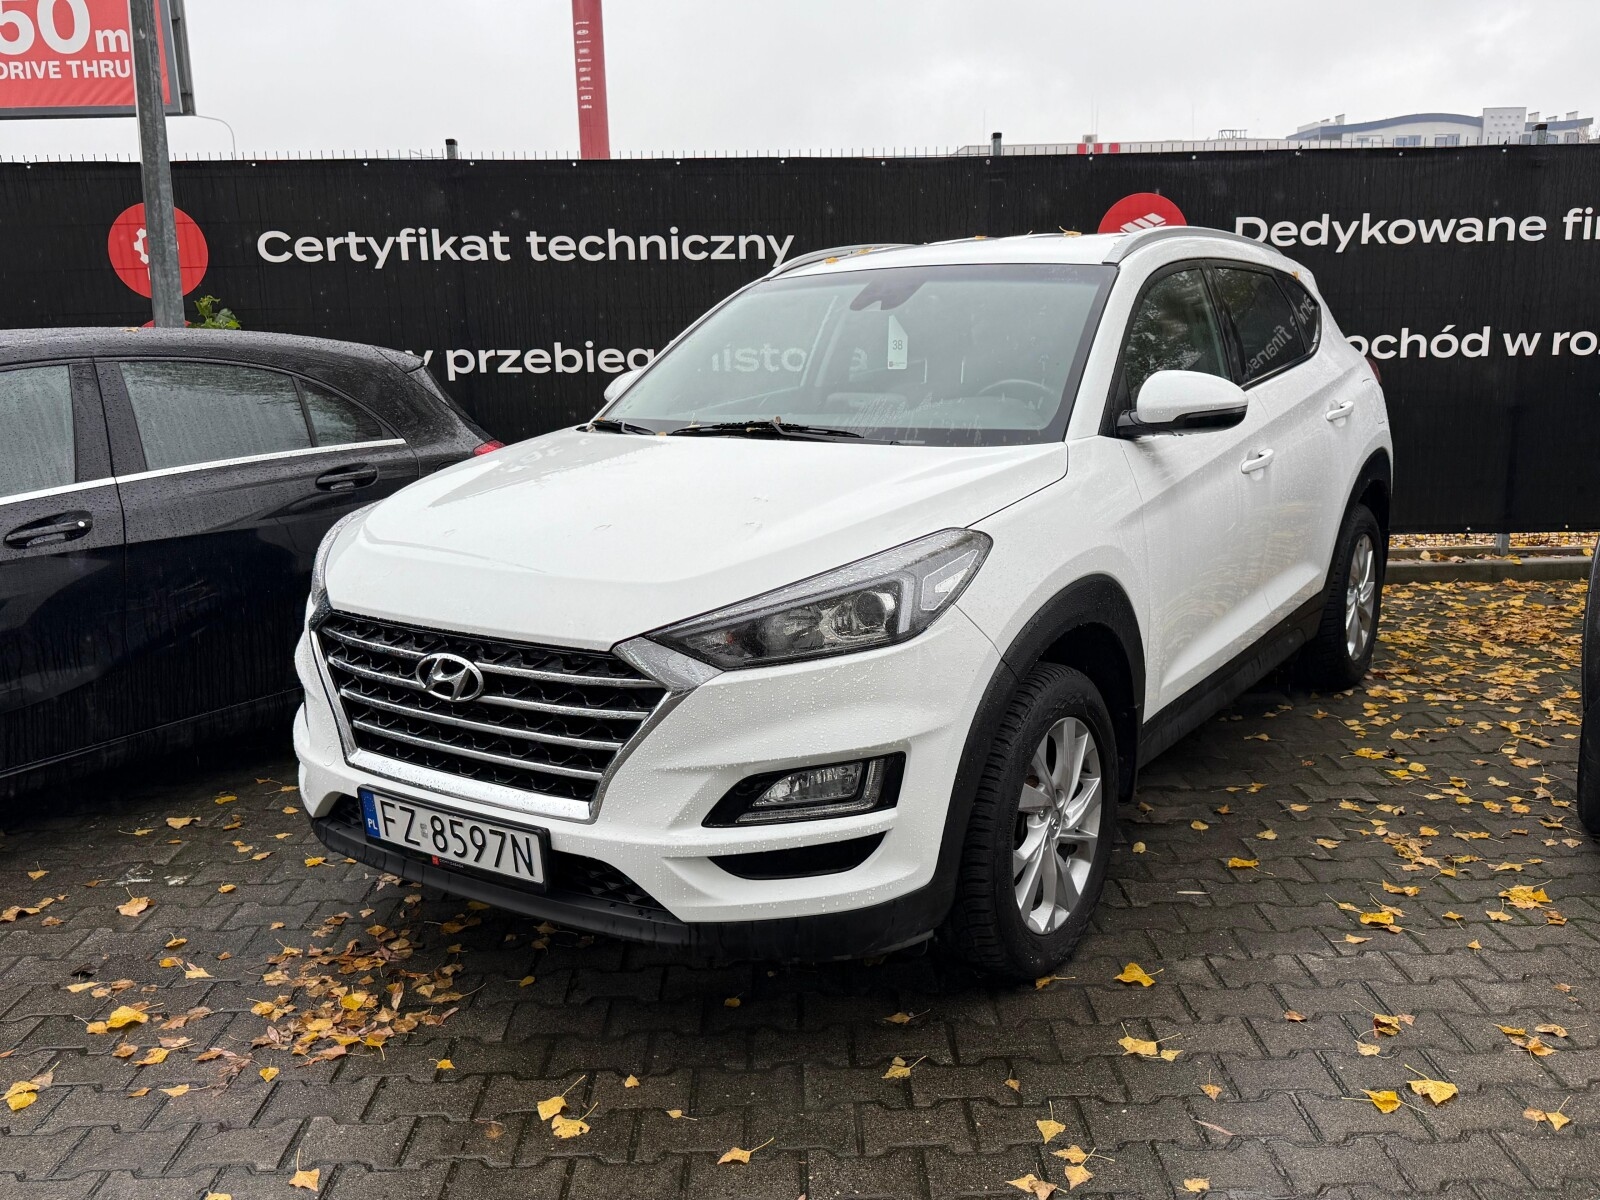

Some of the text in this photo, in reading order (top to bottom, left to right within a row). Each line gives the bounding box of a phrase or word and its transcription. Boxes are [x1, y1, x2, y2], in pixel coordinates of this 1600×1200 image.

[95, 28, 130, 53] m
[66, 59, 131, 79] THRU
[1235, 206, 1600, 253] Dedykowane fi
[257, 226, 794, 269] Certyfikat techniczny
[892, 339, 903, 351] 38
[1344, 324, 1600, 359] ochód w ro
[367, 817, 379, 831] PL
[380, 800, 535, 877] FZ 8597N
